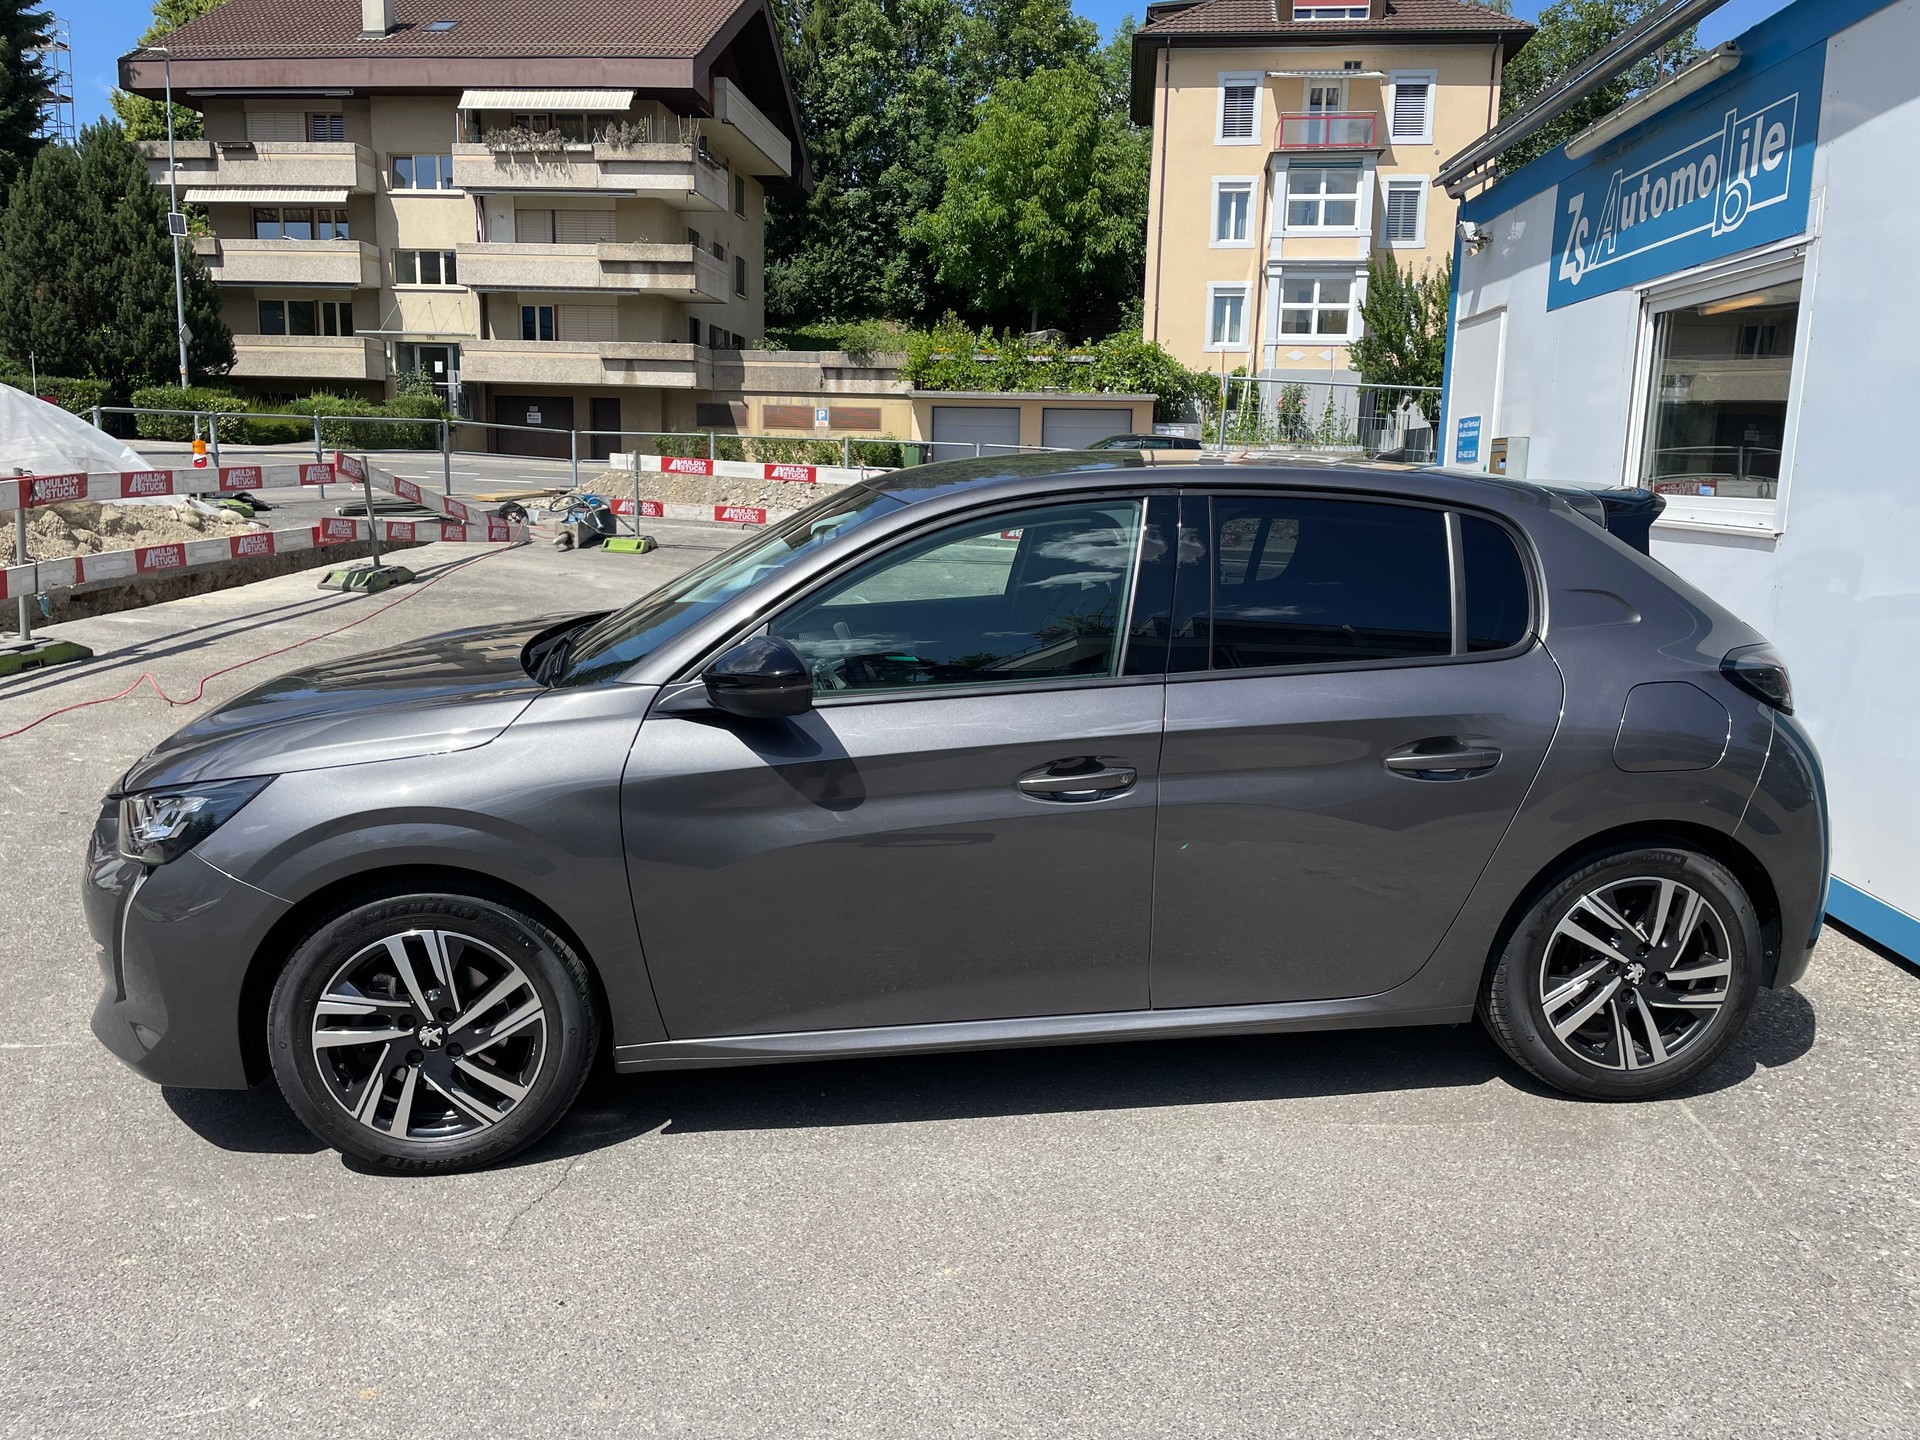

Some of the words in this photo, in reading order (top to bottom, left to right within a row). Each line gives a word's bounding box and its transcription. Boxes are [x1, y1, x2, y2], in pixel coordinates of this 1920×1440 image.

[1588, 107, 1786, 269] Automobile
[818, 410, 826, 420] P
[366, 902, 476, 919] MICHELIN
